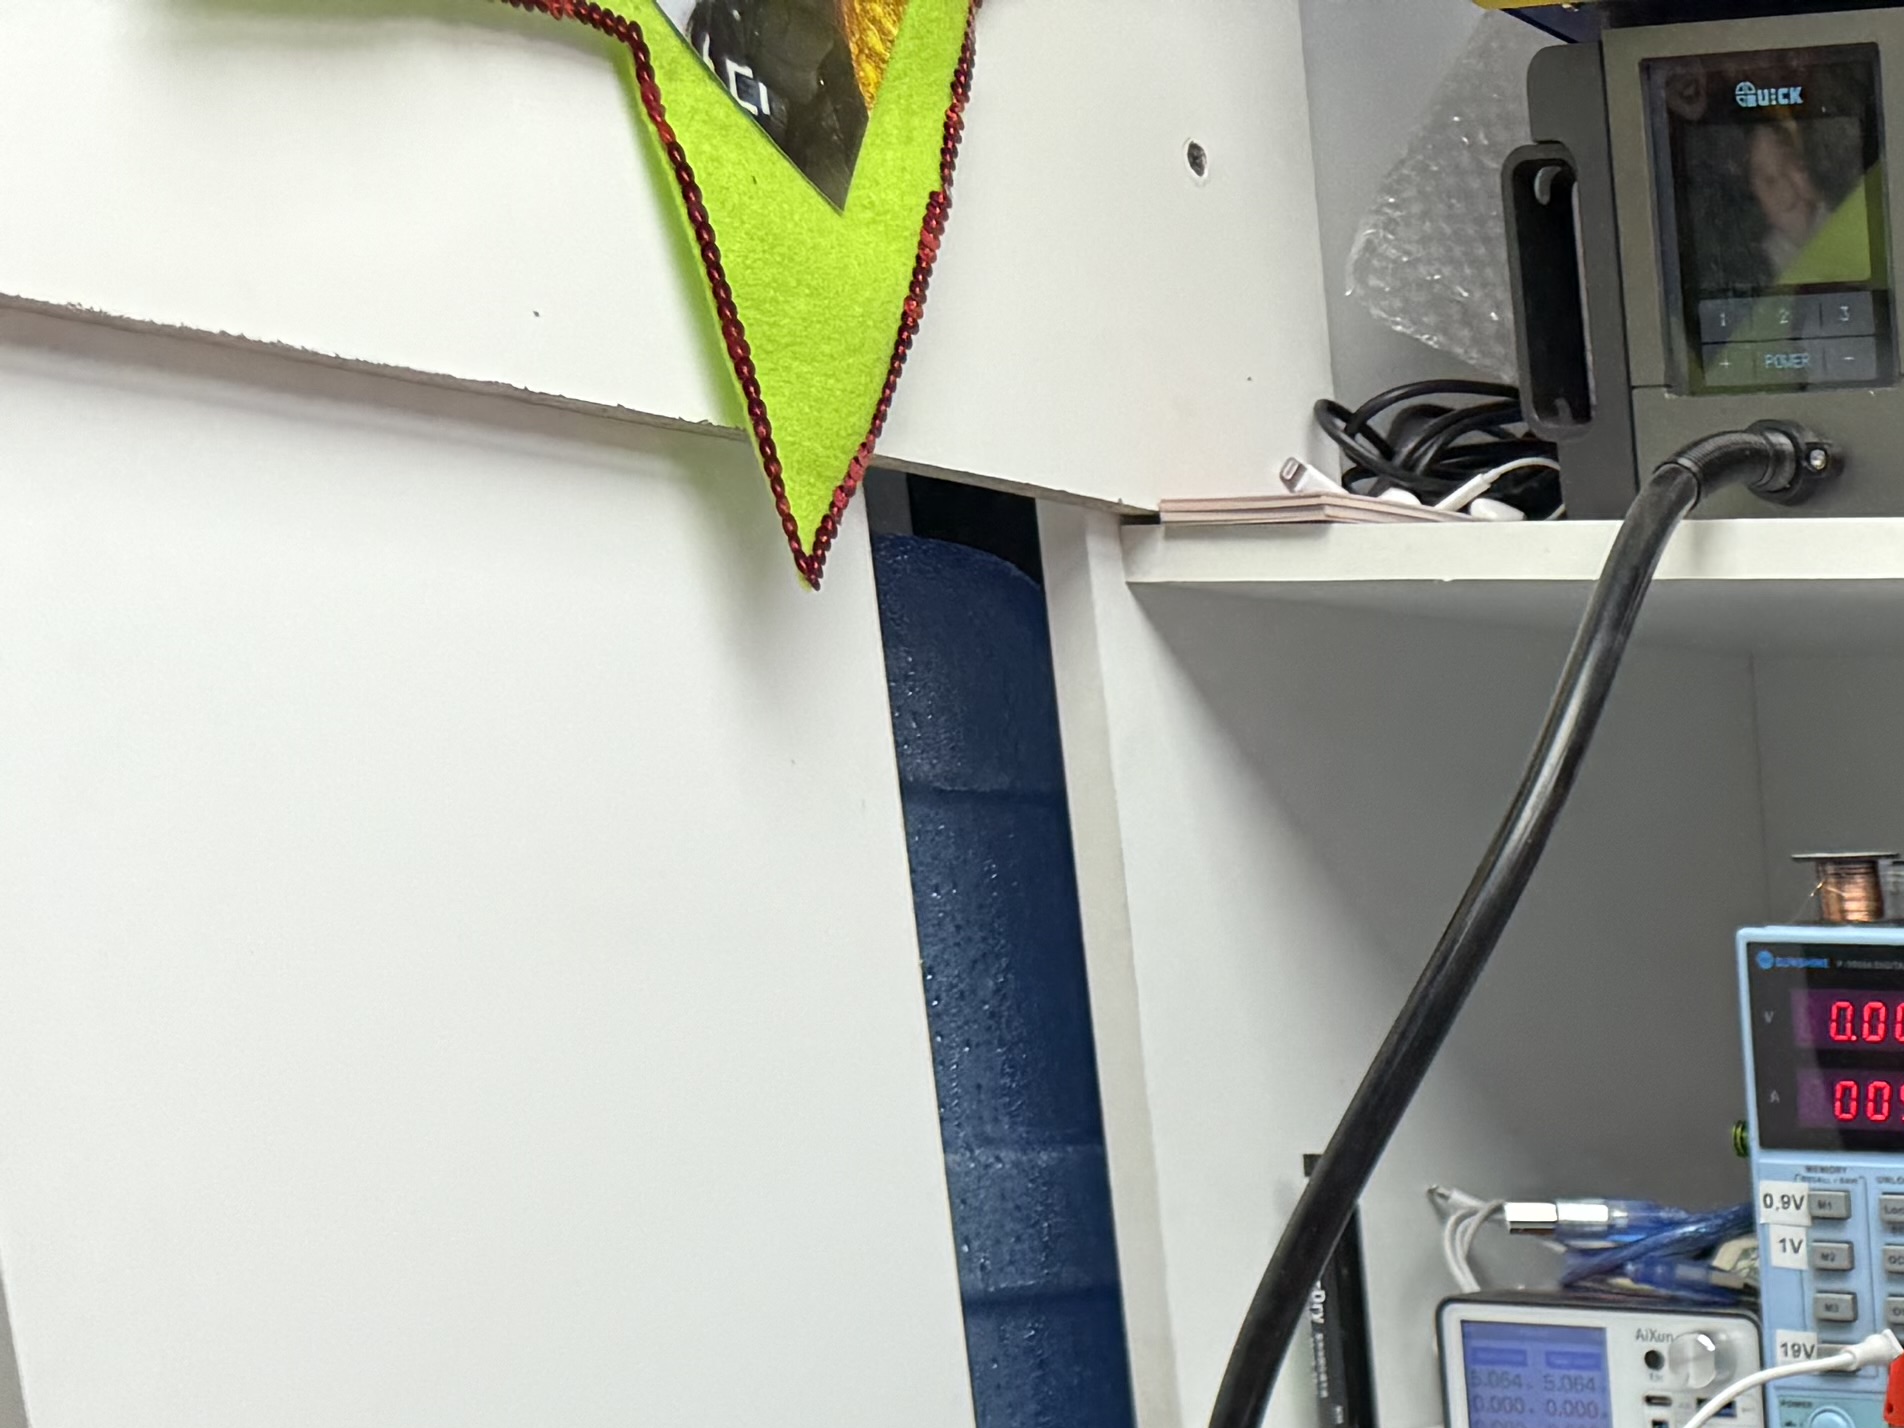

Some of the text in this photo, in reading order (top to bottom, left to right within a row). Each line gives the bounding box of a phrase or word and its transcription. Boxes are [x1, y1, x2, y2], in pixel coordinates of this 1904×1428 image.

[1780, 309, 1789, 323] 2
[1766, 354, 1810, 368] POWER
[1764, 1012, 1774, 1023] V
[1818, 1202, 1832, 1210] M1
[1779, 1239, 1803, 1253] 1V
[1821, 1252, 1836, 1262] M2
[1825, 1304, 1838, 1313] M3
[1780, 1343, 1815, 1357] 19V
